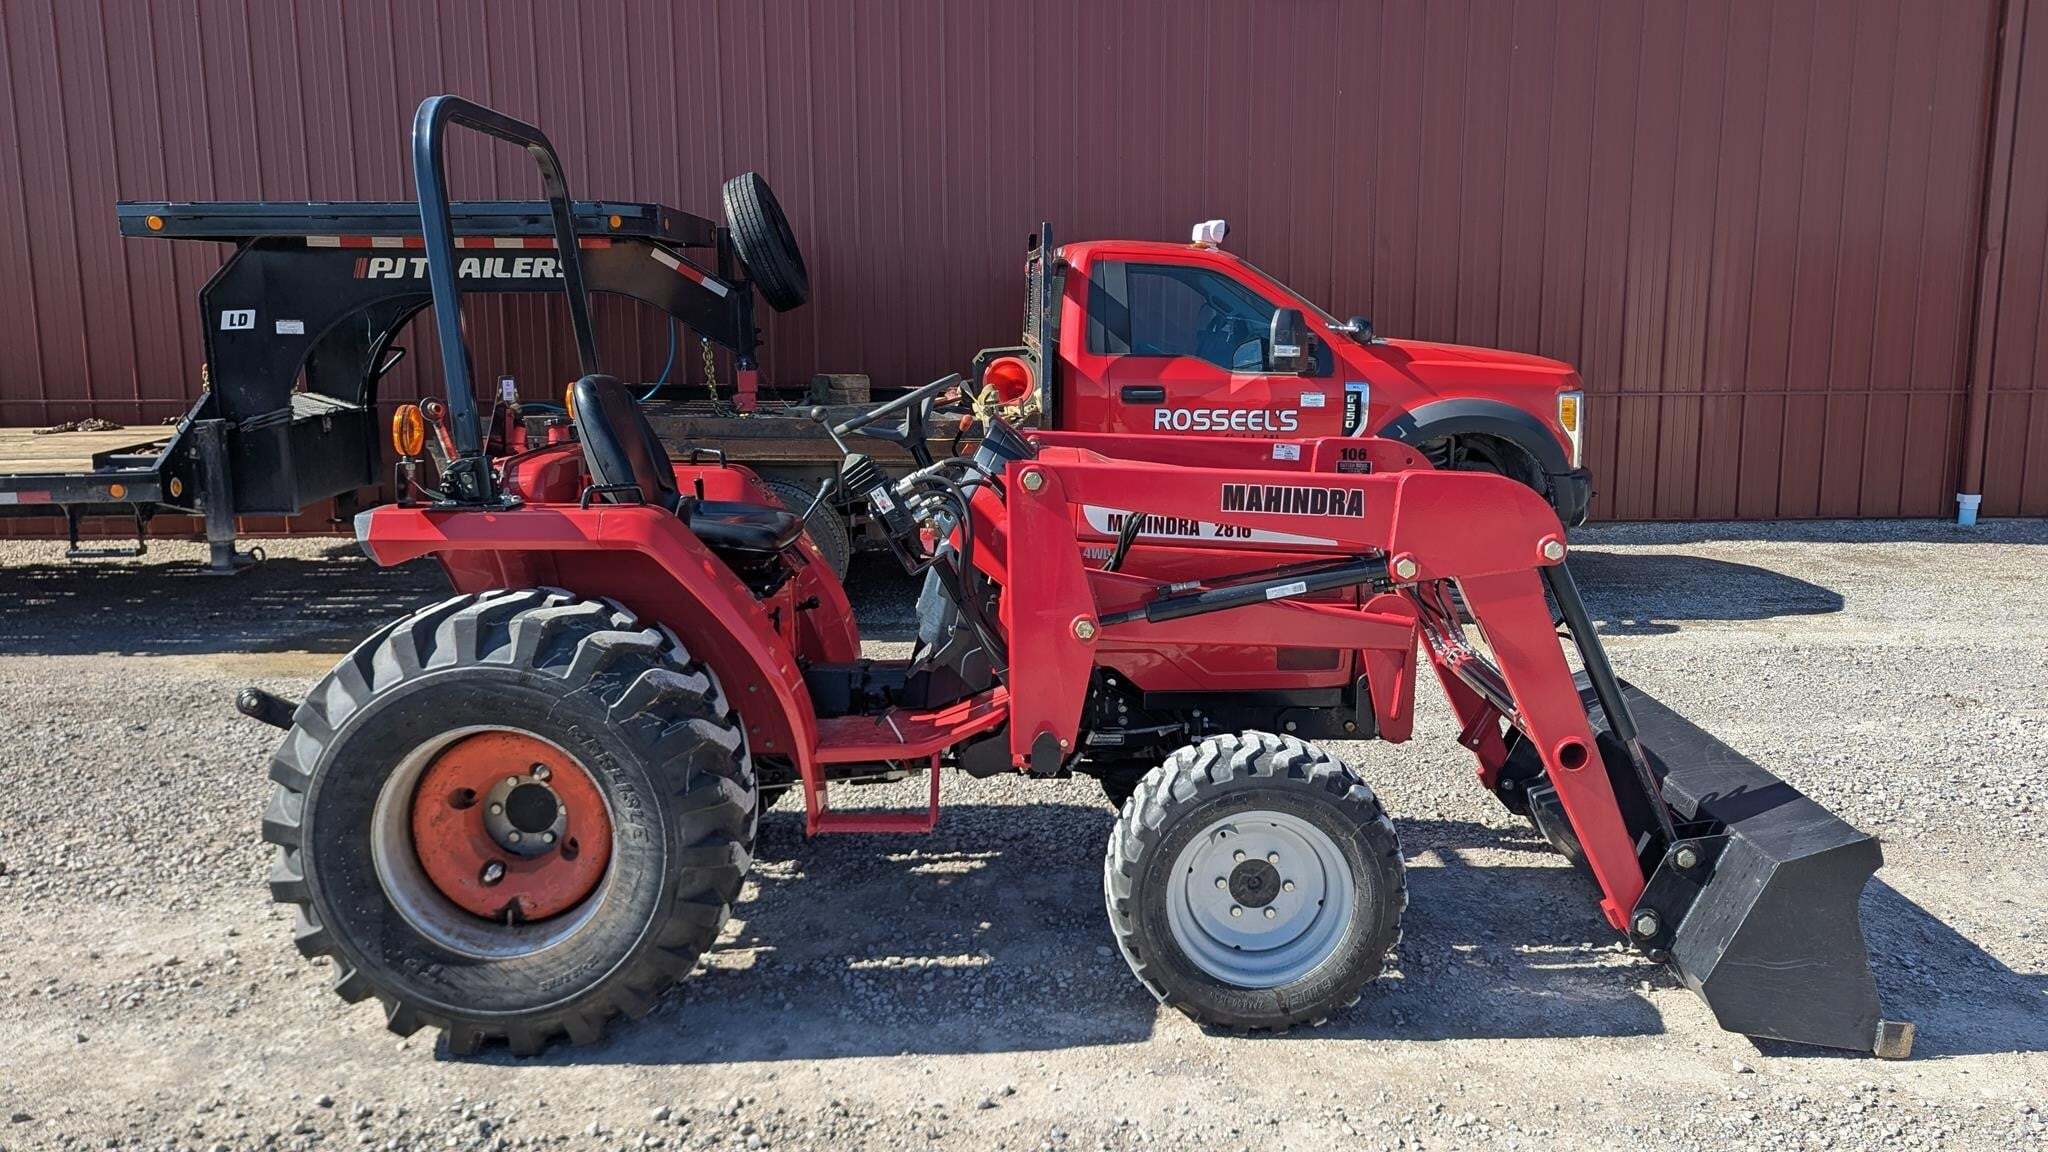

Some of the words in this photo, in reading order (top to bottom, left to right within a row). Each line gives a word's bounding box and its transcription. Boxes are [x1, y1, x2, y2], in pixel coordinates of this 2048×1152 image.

[367, 257, 407, 279] PJ
[409, 257, 565, 279] TAILER
[228, 313, 249, 327] LD
[1153, 408, 1299, 432] ROSSEEL'S
[1340, 447, 1367, 461] 106
[1221, 484, 1365, 518] MAHINDRA
[1107, 513, 1200, 537] MINDRA
